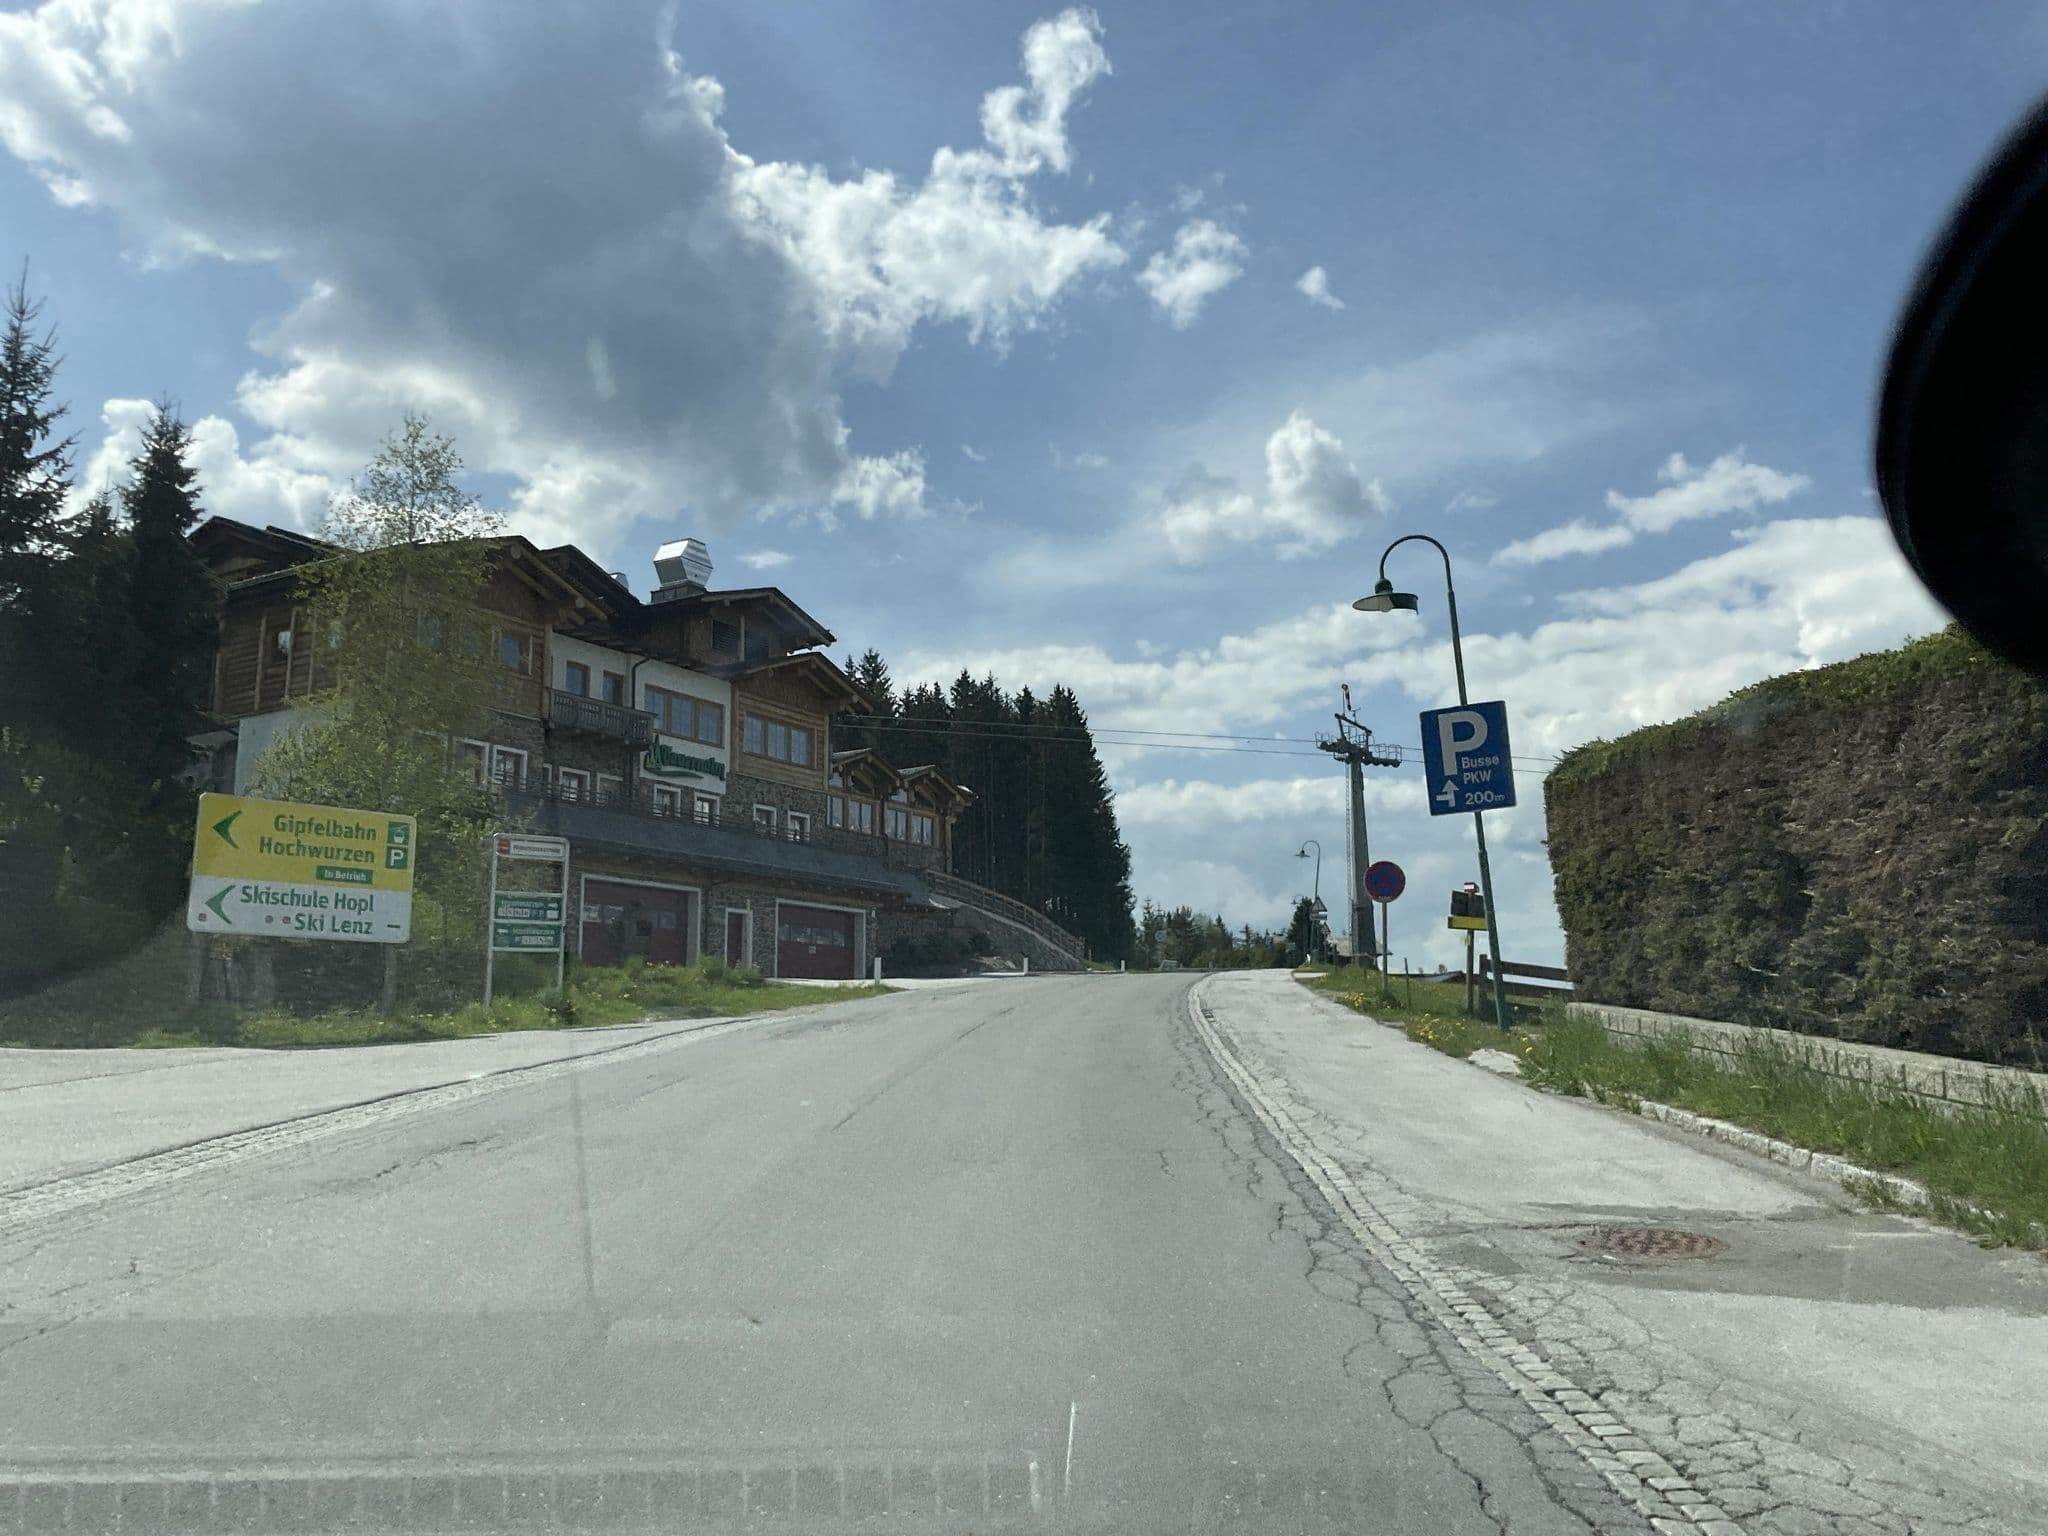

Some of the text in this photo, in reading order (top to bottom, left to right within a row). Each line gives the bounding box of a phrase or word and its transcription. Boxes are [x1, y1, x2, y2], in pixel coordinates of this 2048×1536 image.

[1438, 711, 1488, 776] P
[1461, 756, 1500, 769] Busse
[1463, 770, 1492, 785] PKW
[273, 813, 377, 841] Gipfelbahn
[259, 836, 375, 863] Hochwurzen
[390, 850, 404, 866] P
[335, 870, 367, 881] Betrieb
[240, 885, 374, 916] Skischule Hopl
[294, 913, 373, 935] Ski Lenz
